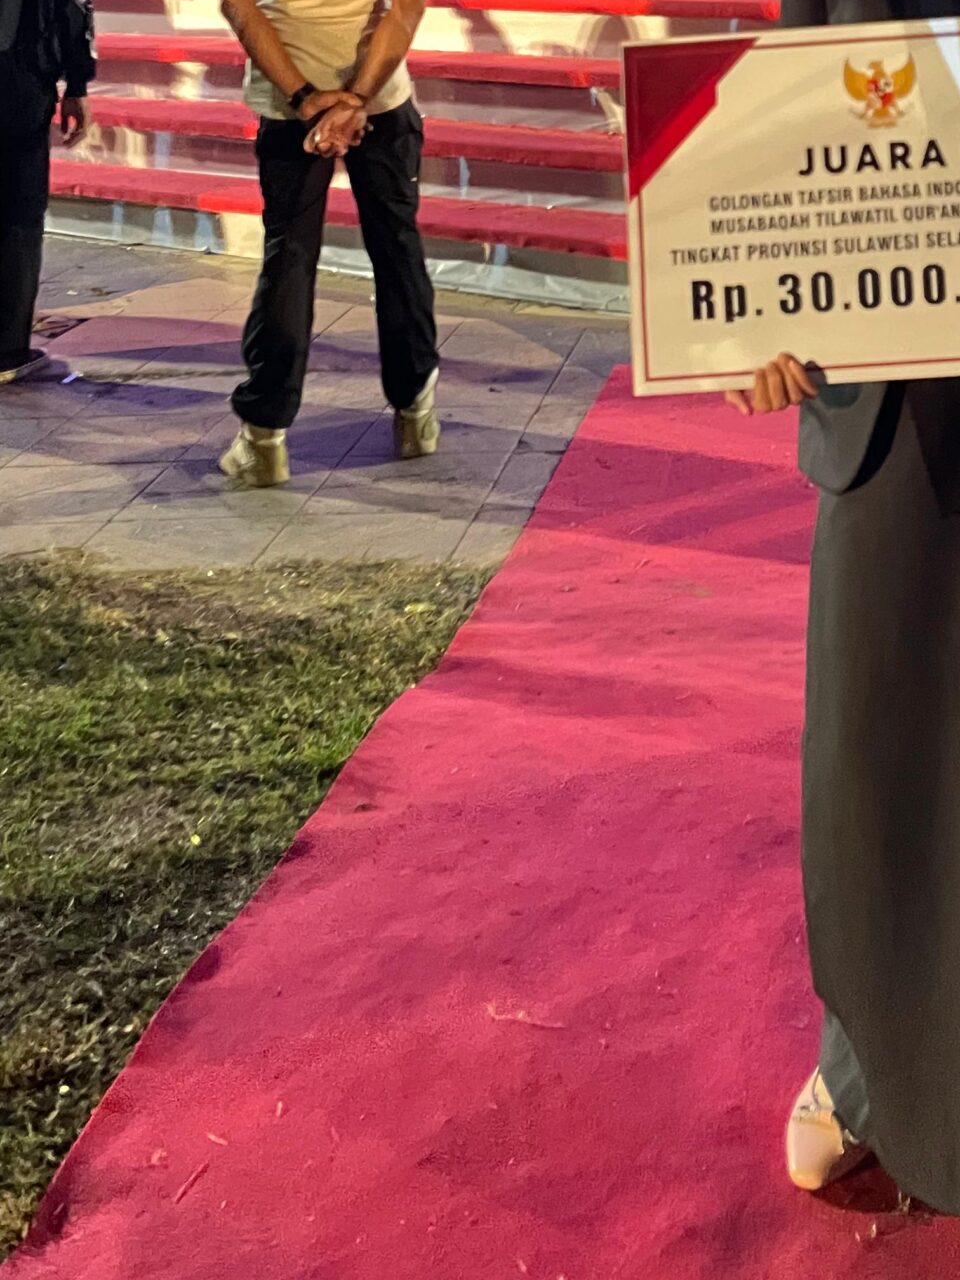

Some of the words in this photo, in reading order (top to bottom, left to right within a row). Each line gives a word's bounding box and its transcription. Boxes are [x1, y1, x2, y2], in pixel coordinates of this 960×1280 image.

[798, 139, 946, 177] JUARA
[709, 191, 793, 213] GOLONGAN
[798, 186, 853, 206] TAFSIR
[858, 181, 922, 202] BAHASA
[711, 214, 811, 236] MUSABAQAH
[816, 207, 898, 228] TILAWATIL
[903, 204, 960, 222] QUR'AN
[671, 245, 741, 266] TINGKAT
[747, 239, 827, 261] PROVINSI
[832, 233, 920, 256] SULAWESI
[691, 279, 764, 324] Rp.
